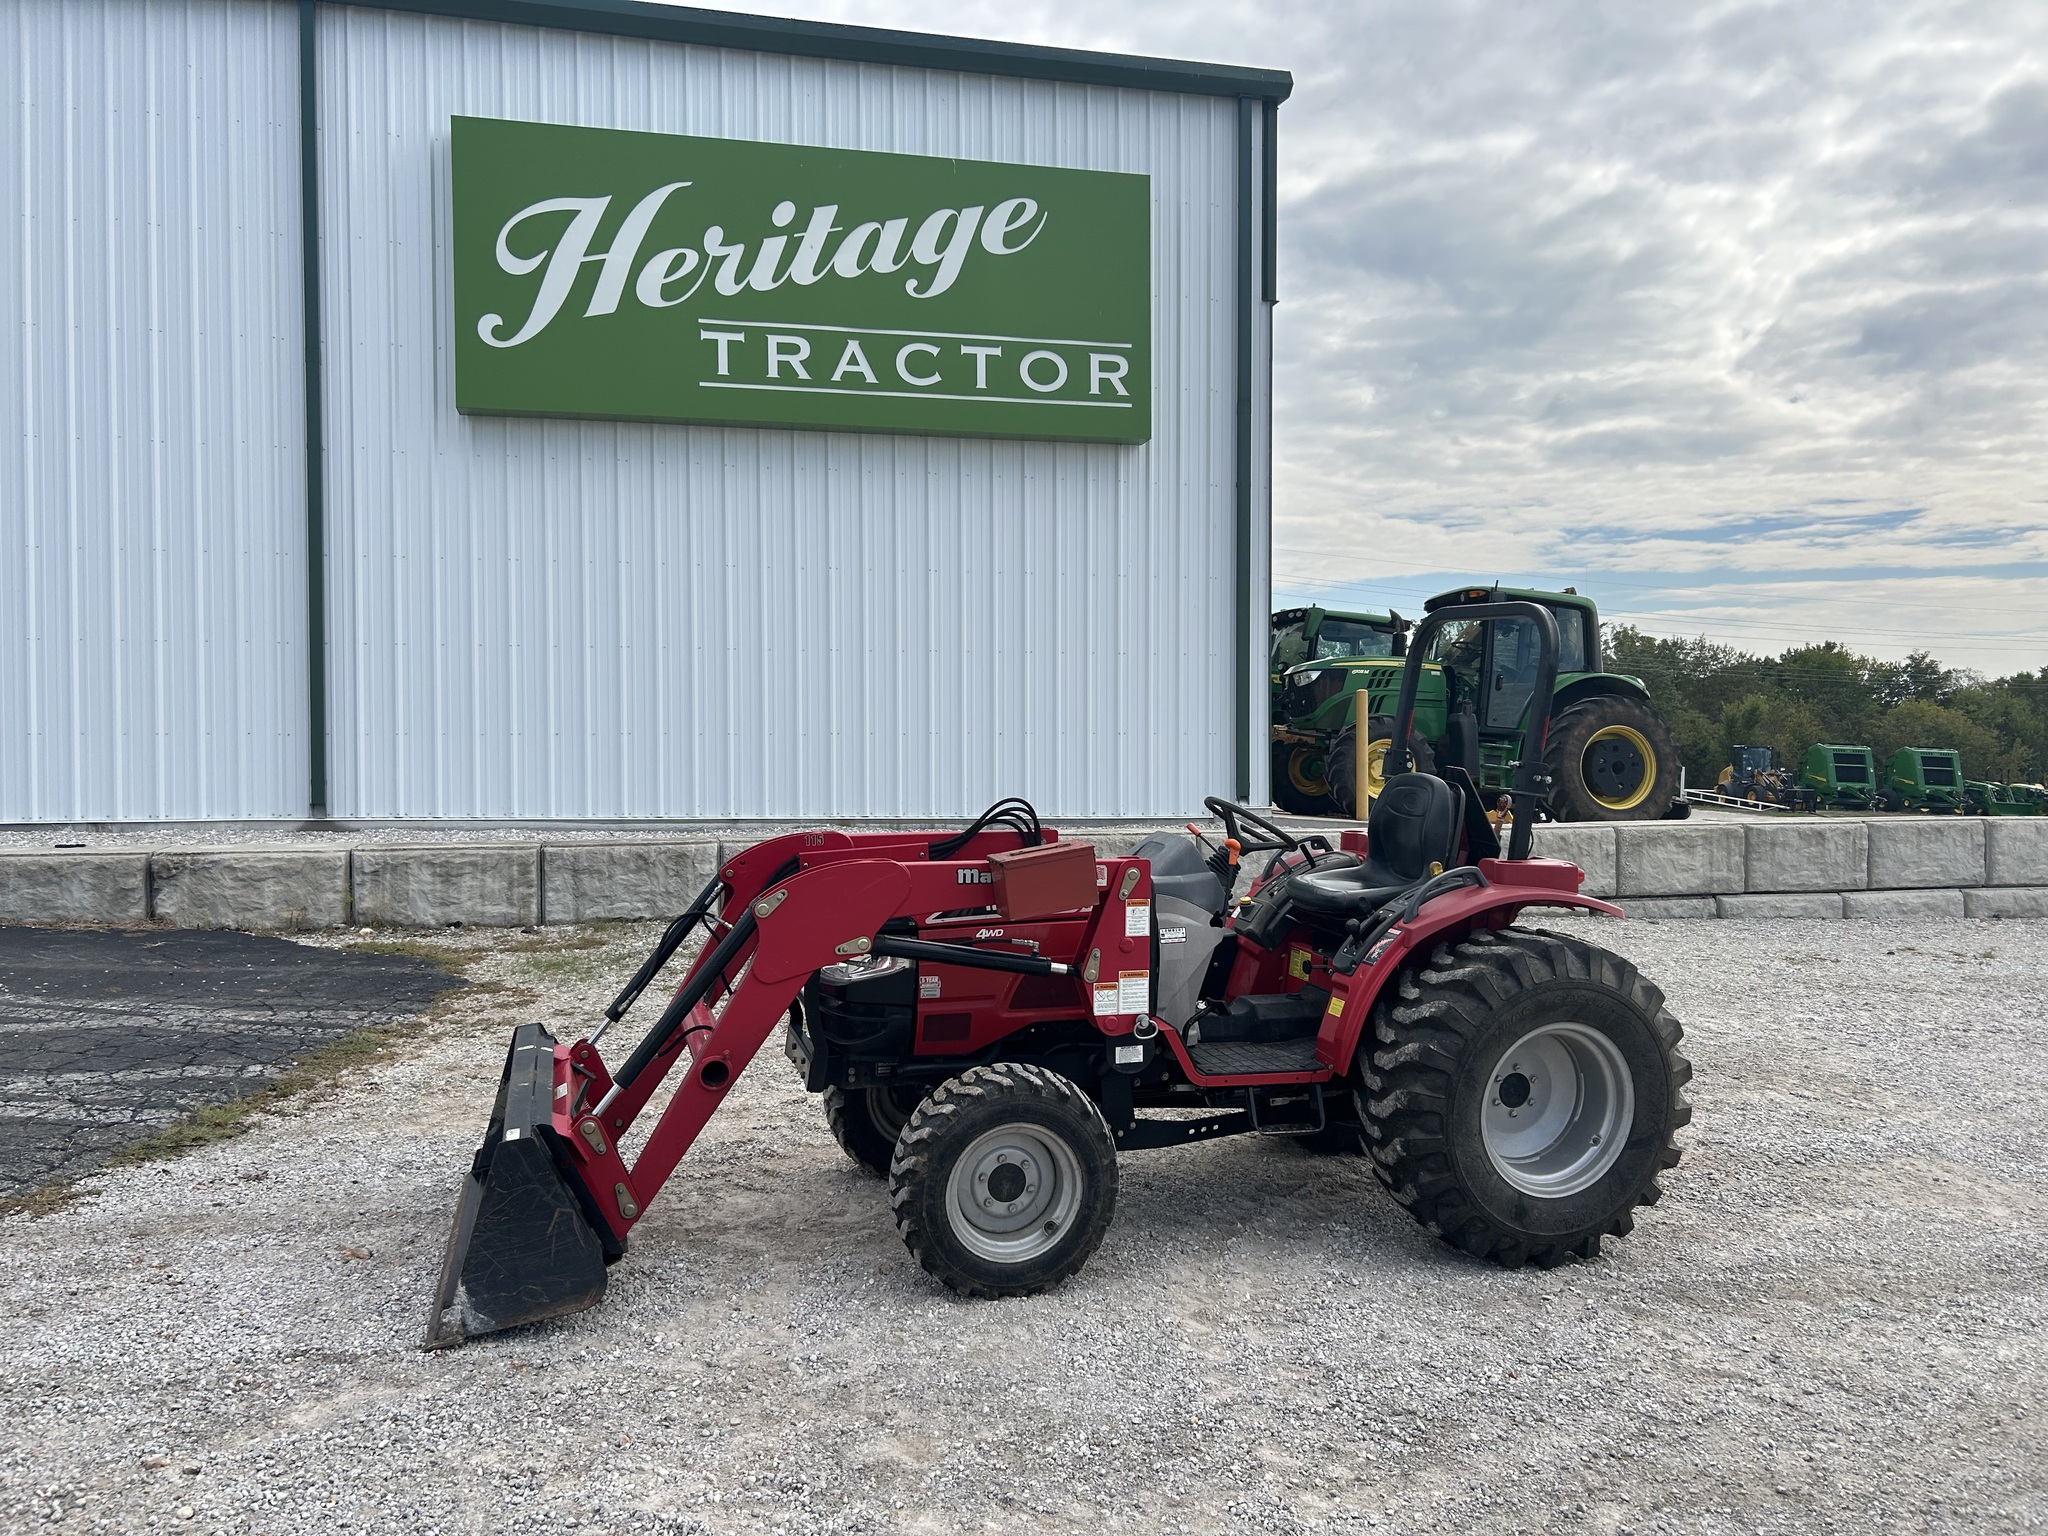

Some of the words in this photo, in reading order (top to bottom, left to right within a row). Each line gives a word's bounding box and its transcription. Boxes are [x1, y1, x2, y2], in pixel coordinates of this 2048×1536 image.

[477, 181, 1048, 349] Heritage
[699, 328, 1132, 397] TRACTOR
[804, 833, 825, 847] 115
[957, 868, 993, 885] Ma
[976, 928, 1004, 939] 4WD
